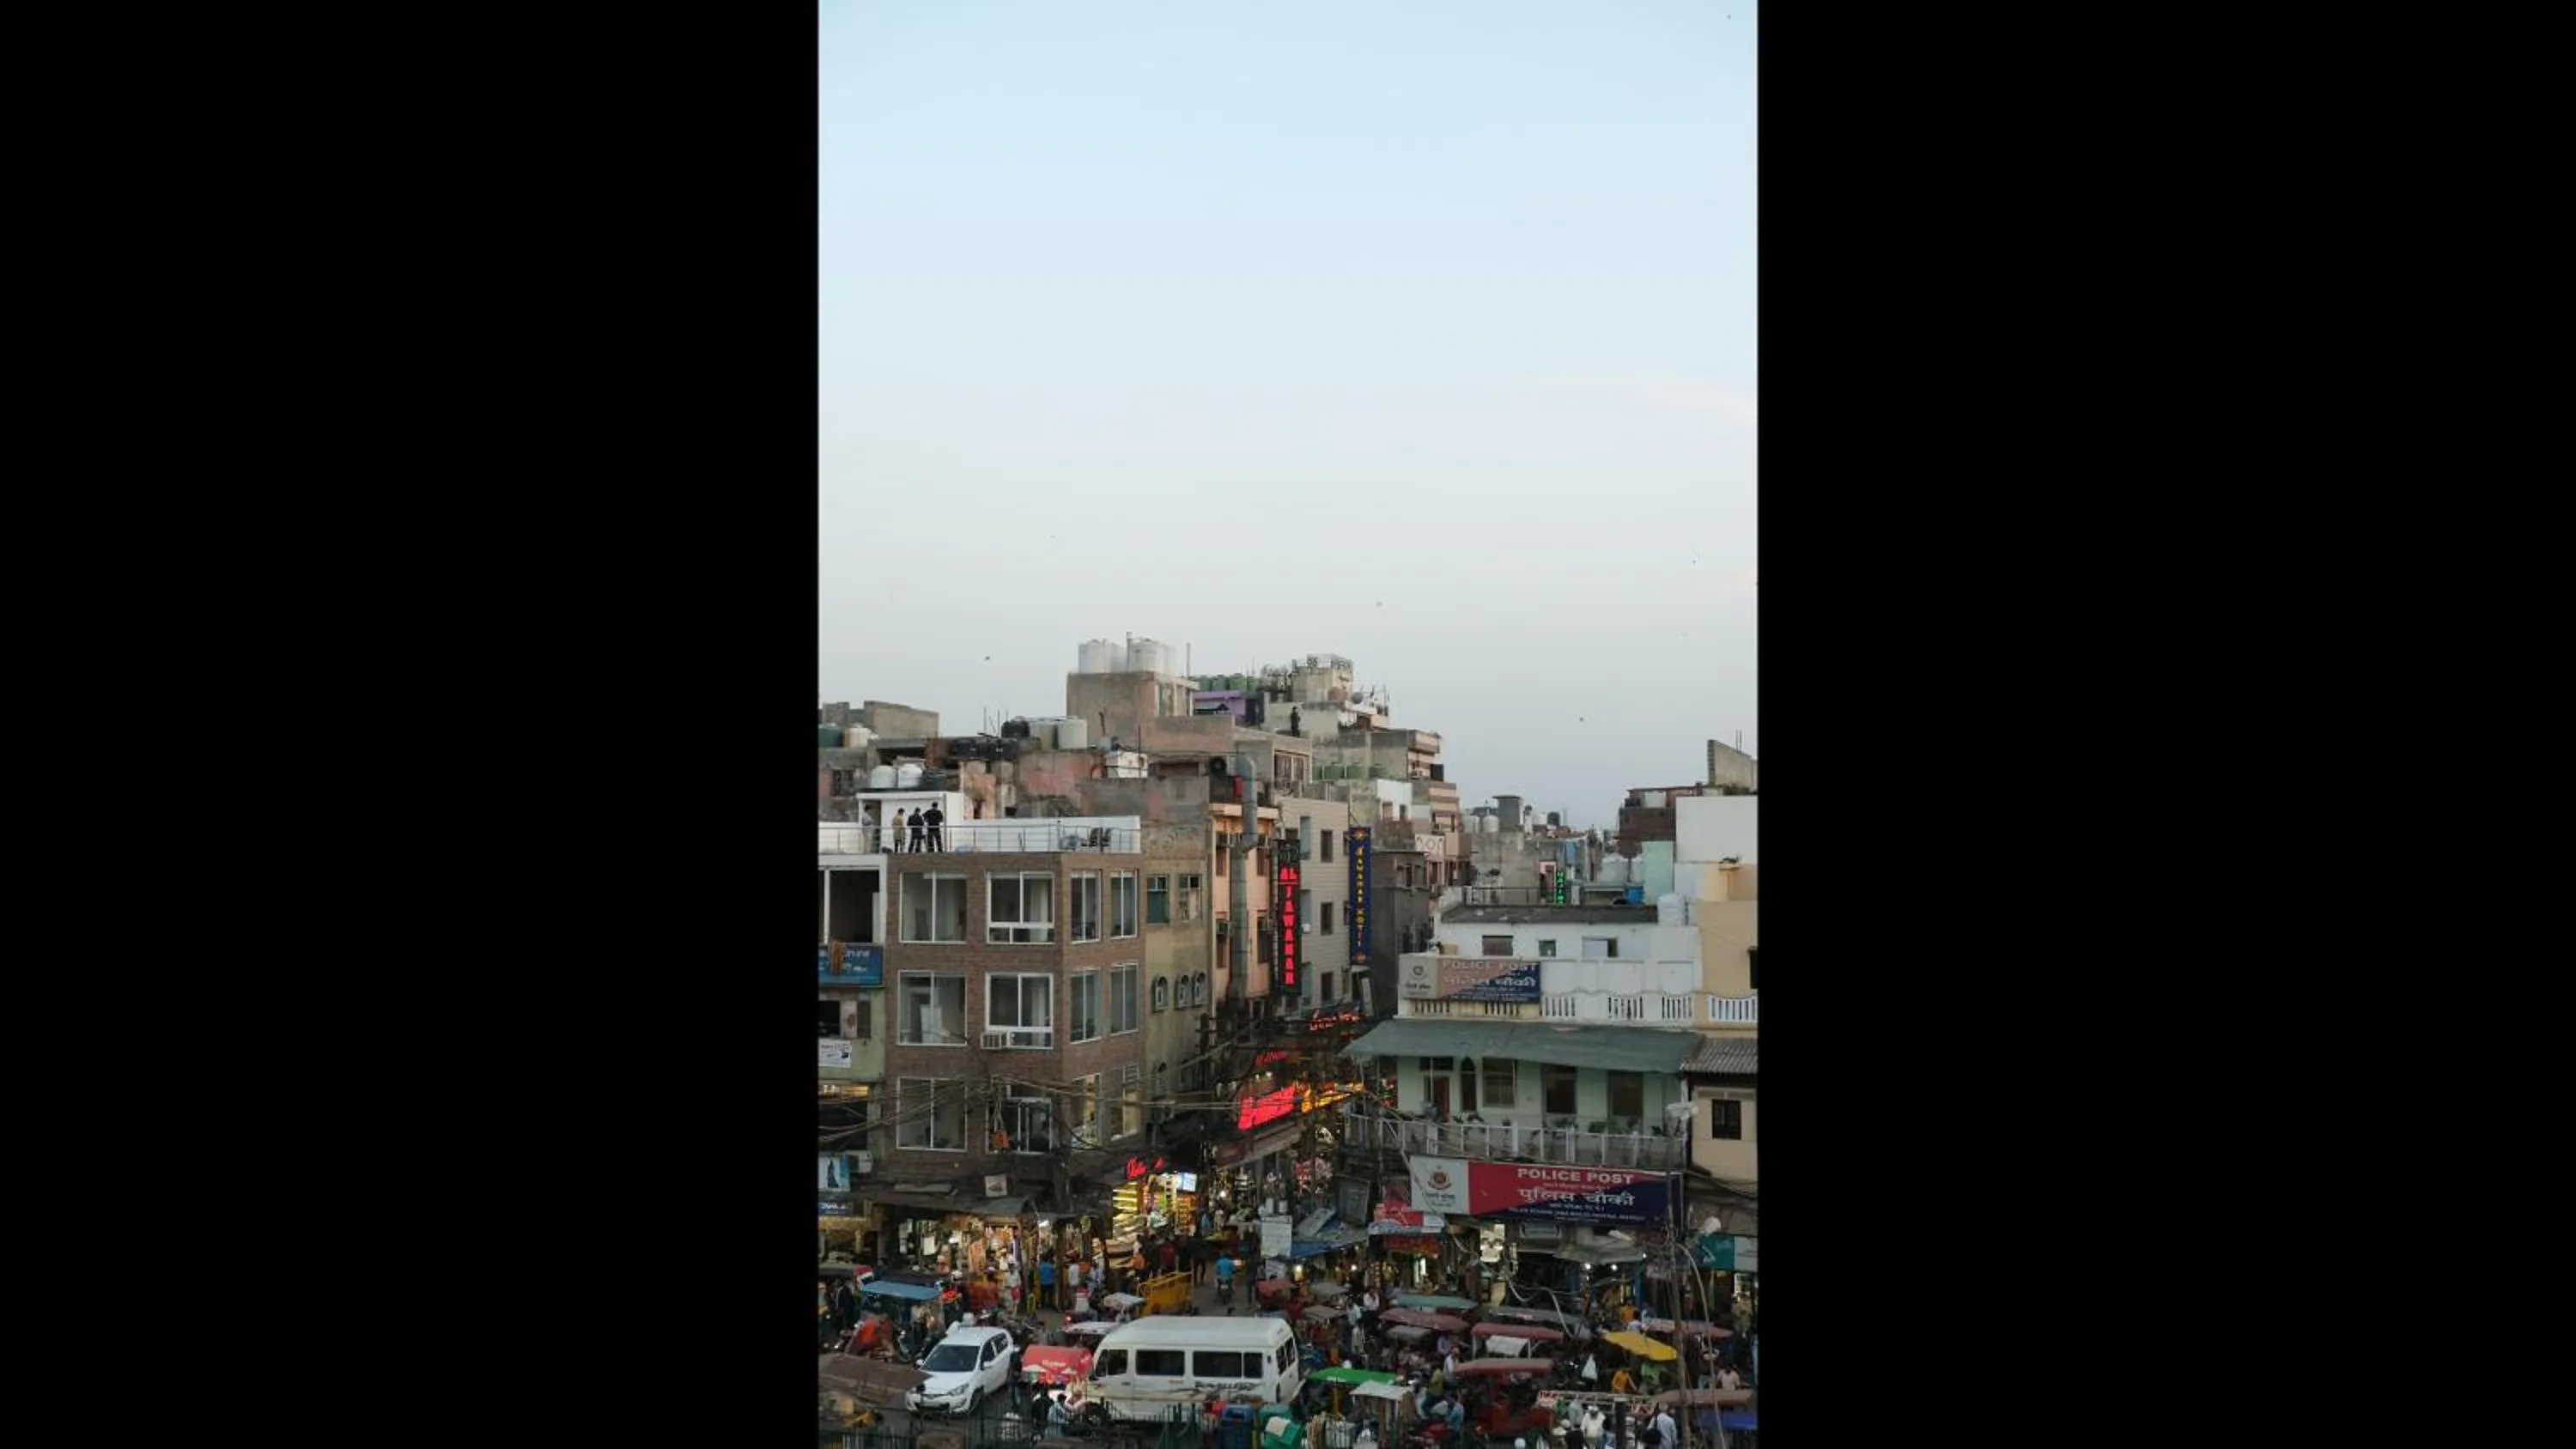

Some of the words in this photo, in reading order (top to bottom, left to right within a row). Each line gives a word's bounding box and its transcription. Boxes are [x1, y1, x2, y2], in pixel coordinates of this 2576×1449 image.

[1279, 867, 1298, 881] AL
[1282, 885, 1296, 985] JAWAHAR
[1442, 960, 1494, 970] POLICE
[1499, 961, 1538, 972] POST
[1517, 1167, 1581, 1181] POLICE
[1587, 1170, 1634, 1185] POST
[1518, 1186, 1576, 1204] पुलिस
[1584, 1188, 1636, 1206] चौकी
